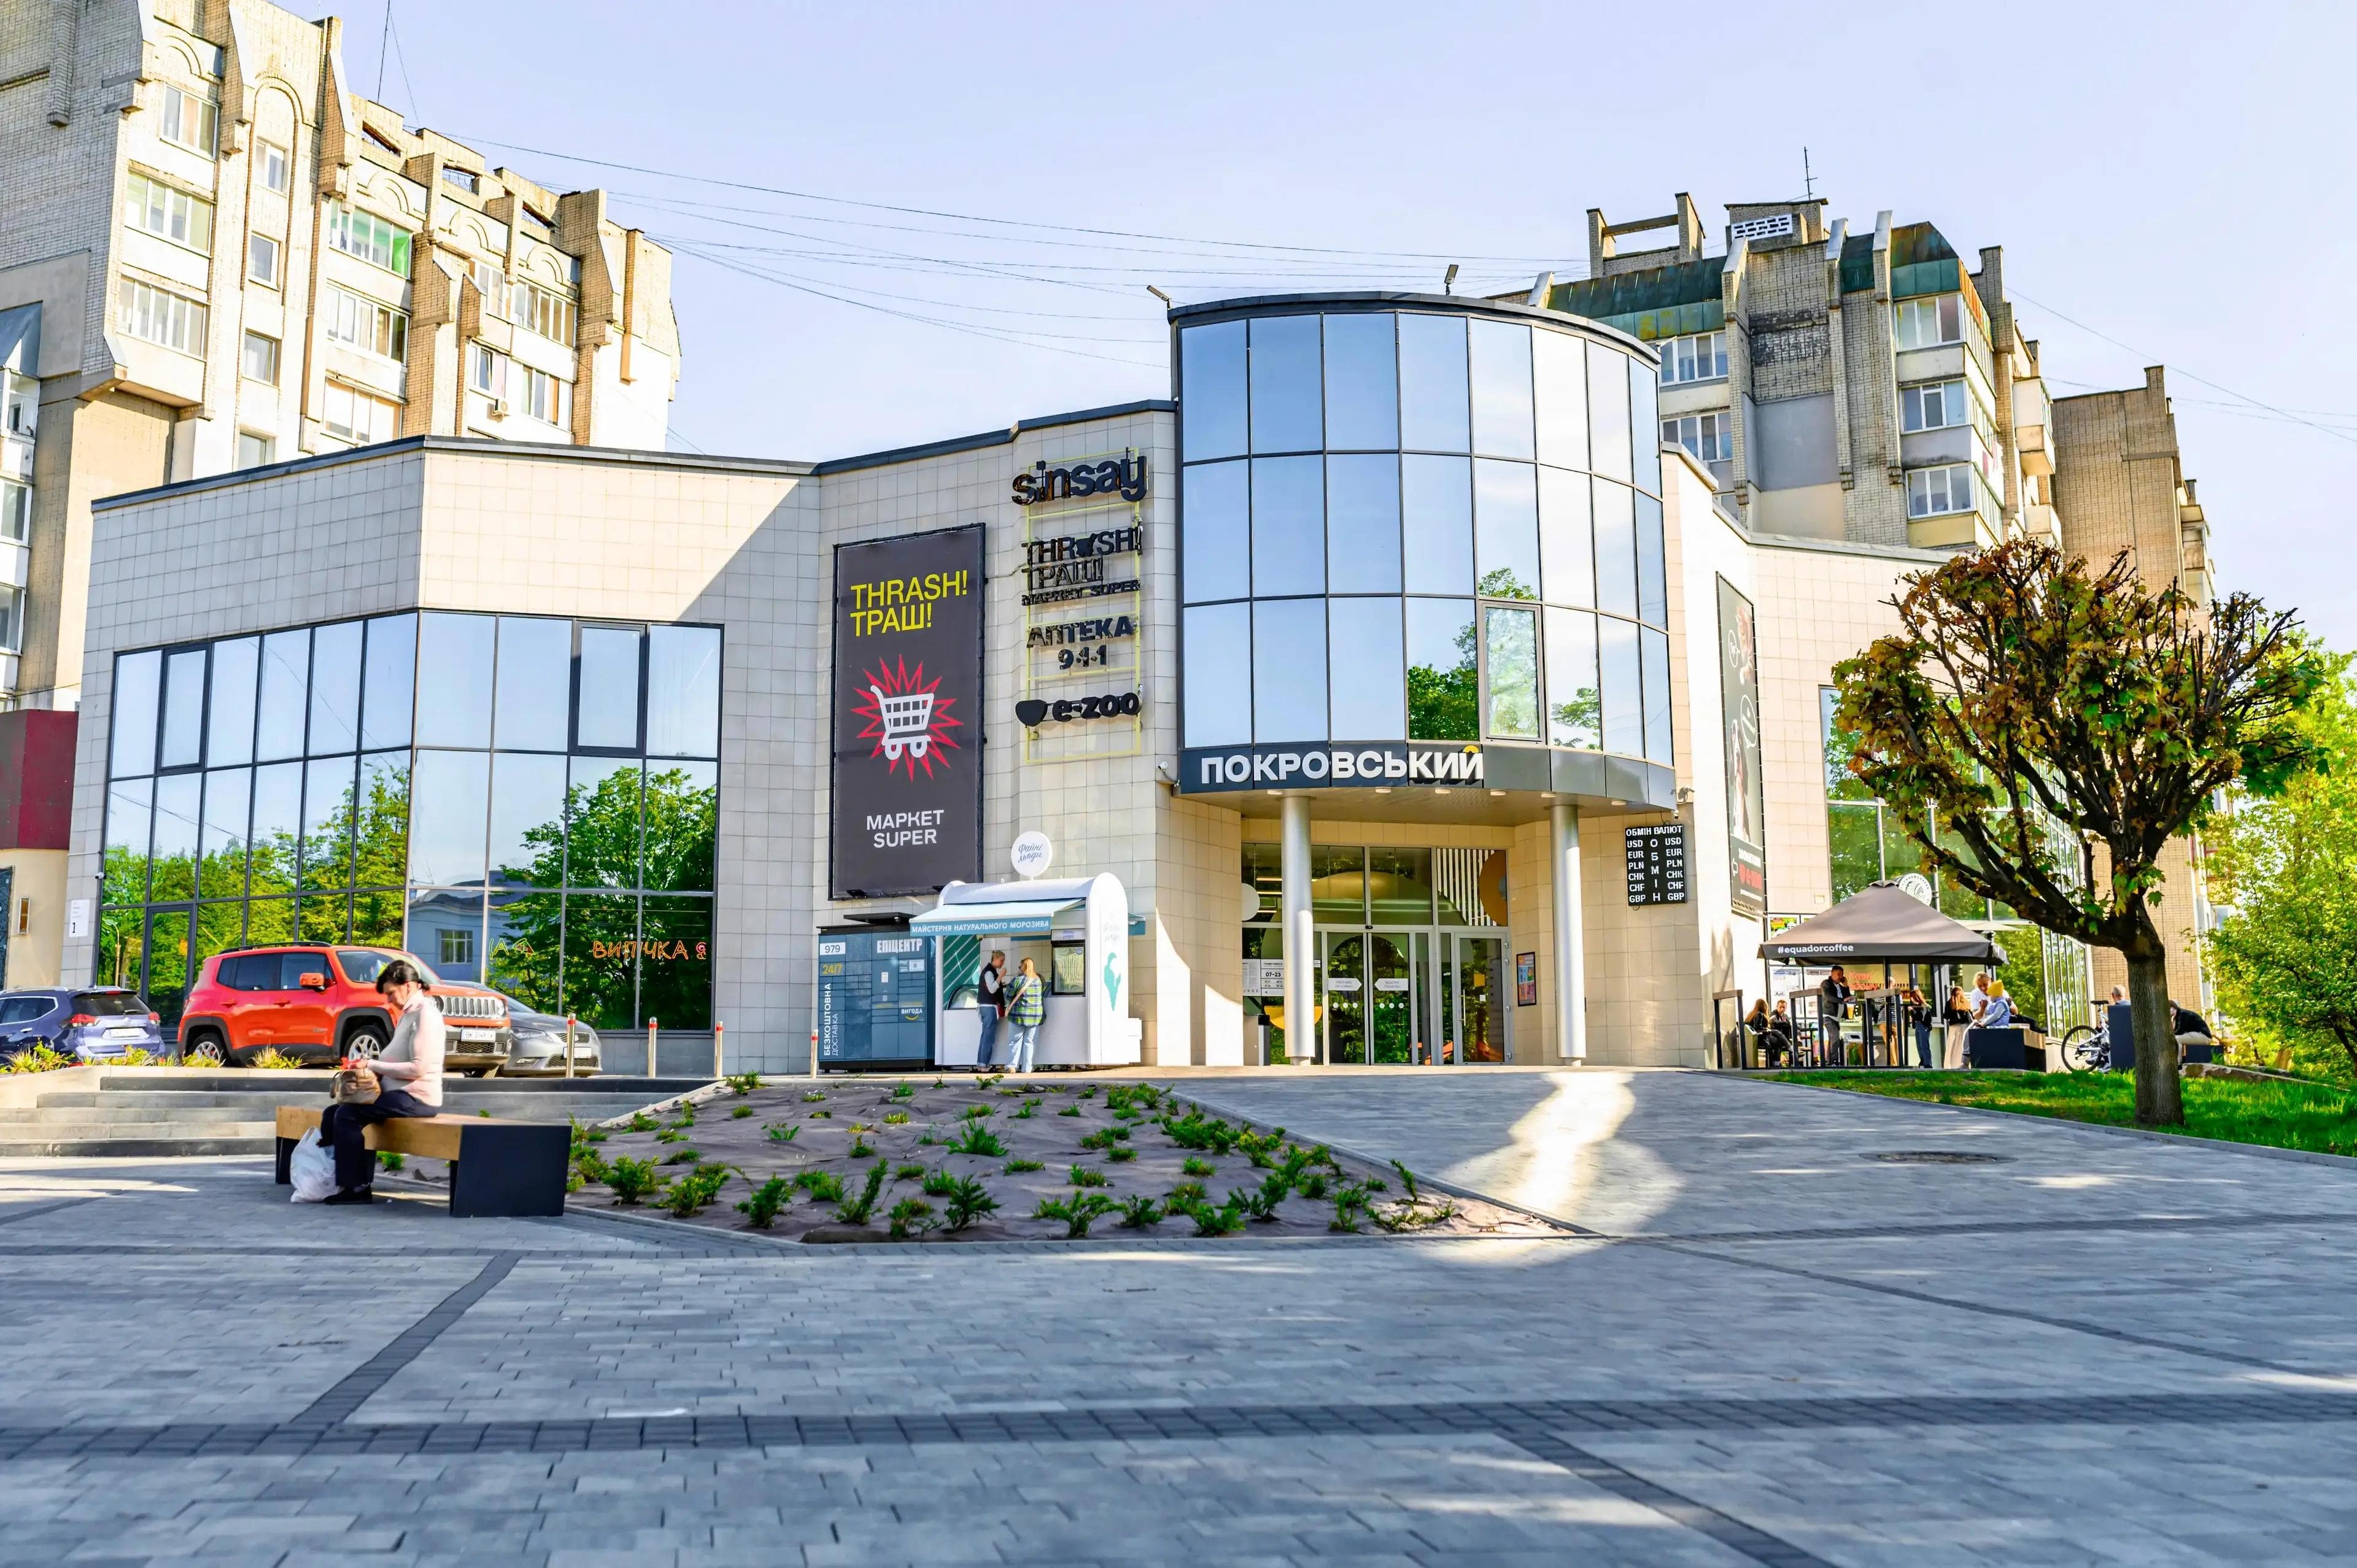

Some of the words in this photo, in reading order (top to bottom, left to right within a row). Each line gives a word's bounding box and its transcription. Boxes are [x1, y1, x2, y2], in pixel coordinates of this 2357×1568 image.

[1012, 456, 1147, 506] sinsay
[851, 570, 968, 609] THRASH!
[1090, 579, 1141, 597] SUPER
[850, 603, 932, 637] ТРАШ!
[1026, 616, 1135, 648] АПТЕКА
[1201, 745, 1484, 784] ПОКРОВСЬКИЙ
[867, 809, 944, 830] МАРКЕТ
[873, 829, 937, 848] SUPER
[1626, 827, 1651, 836] ОБМІН
[1654, 825, 1682, 835] ВАЛЮТ
[72, 922, 75, 933] 1
[912, 924, 952, 933] МАЙСТЕРНЯ
[954, 922, 1007, 931] НАТУРАЛЬНОГО
[1010, 920, 1049, 929] МОРОЗИВА
[825, 944, 840, 953] 979
[877, 938, 923, 954] ЕПІЦЕНТР
[1778, 944, 1854, 954] #equadorcoffee
[822, 964, 842, 975] 24/7
